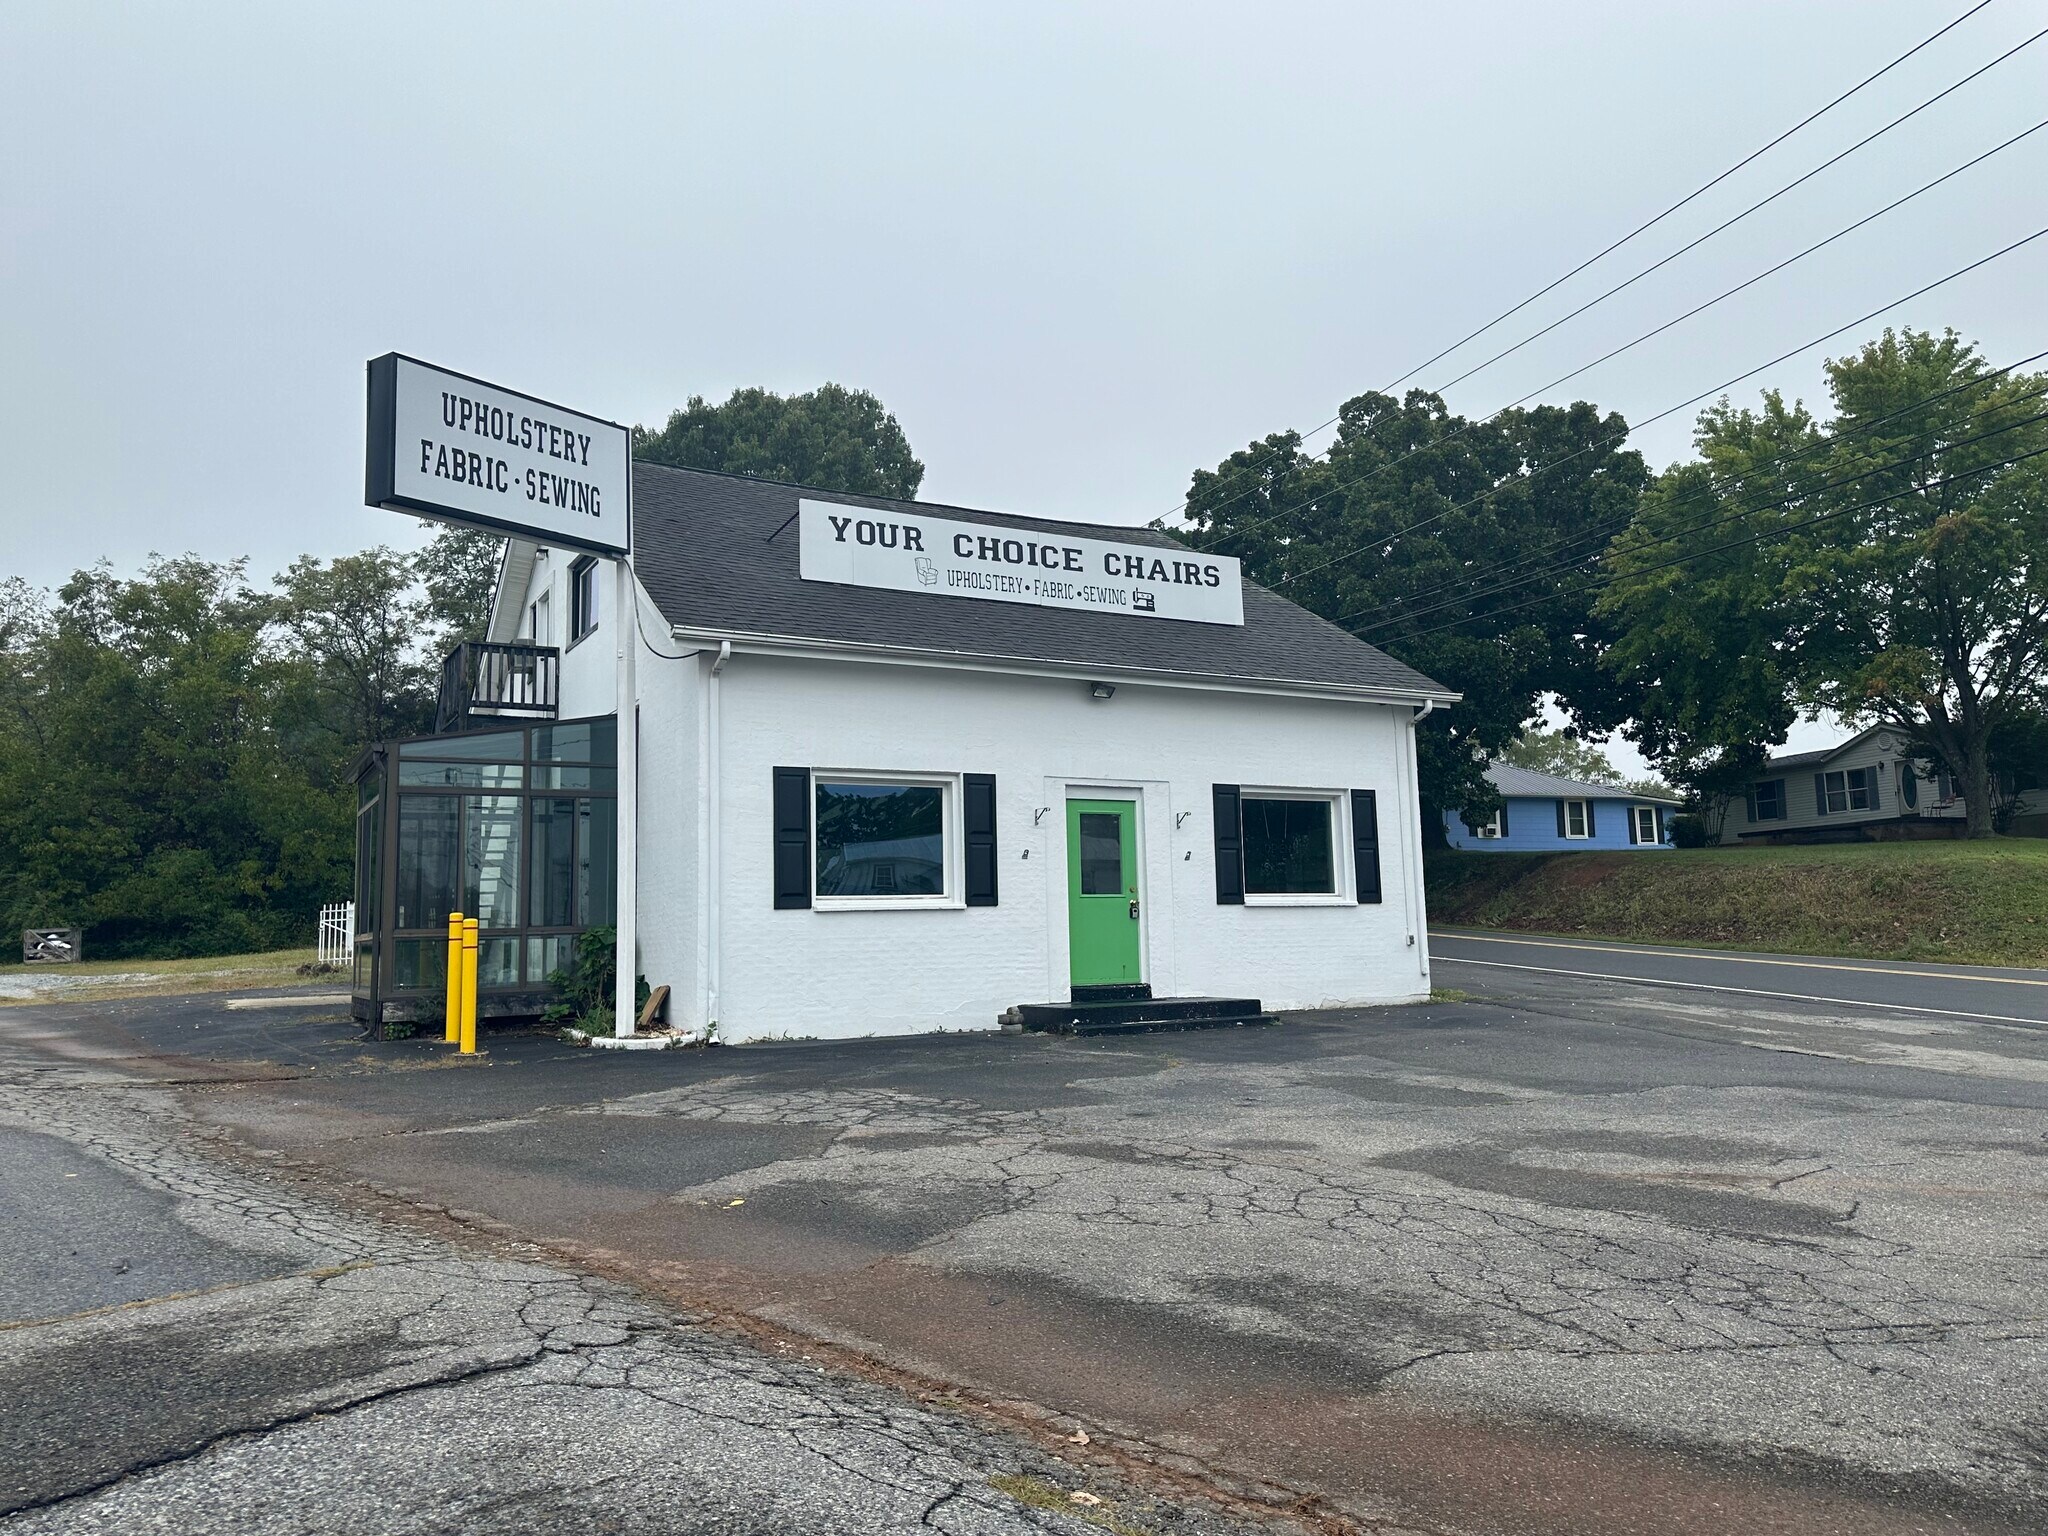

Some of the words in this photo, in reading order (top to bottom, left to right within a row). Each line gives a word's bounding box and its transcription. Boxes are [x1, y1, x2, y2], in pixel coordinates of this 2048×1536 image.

[442, 392, 591, 466] UPHOLSTERY
[421, 439, 508, 493] FABRIC
[526, 468, 600, 517] SEWING
[828, 516, 924, 552] YOUR
[953, 533, 1084, 572] CHOICE
[1104, 553, 1220, 588] CHAIRS
[947, 569, 1023, 594] UPHOLSTERY
[1034, 580, 1075, 600] FABRIC
[1083, 586, 1127, 606] SEWING
